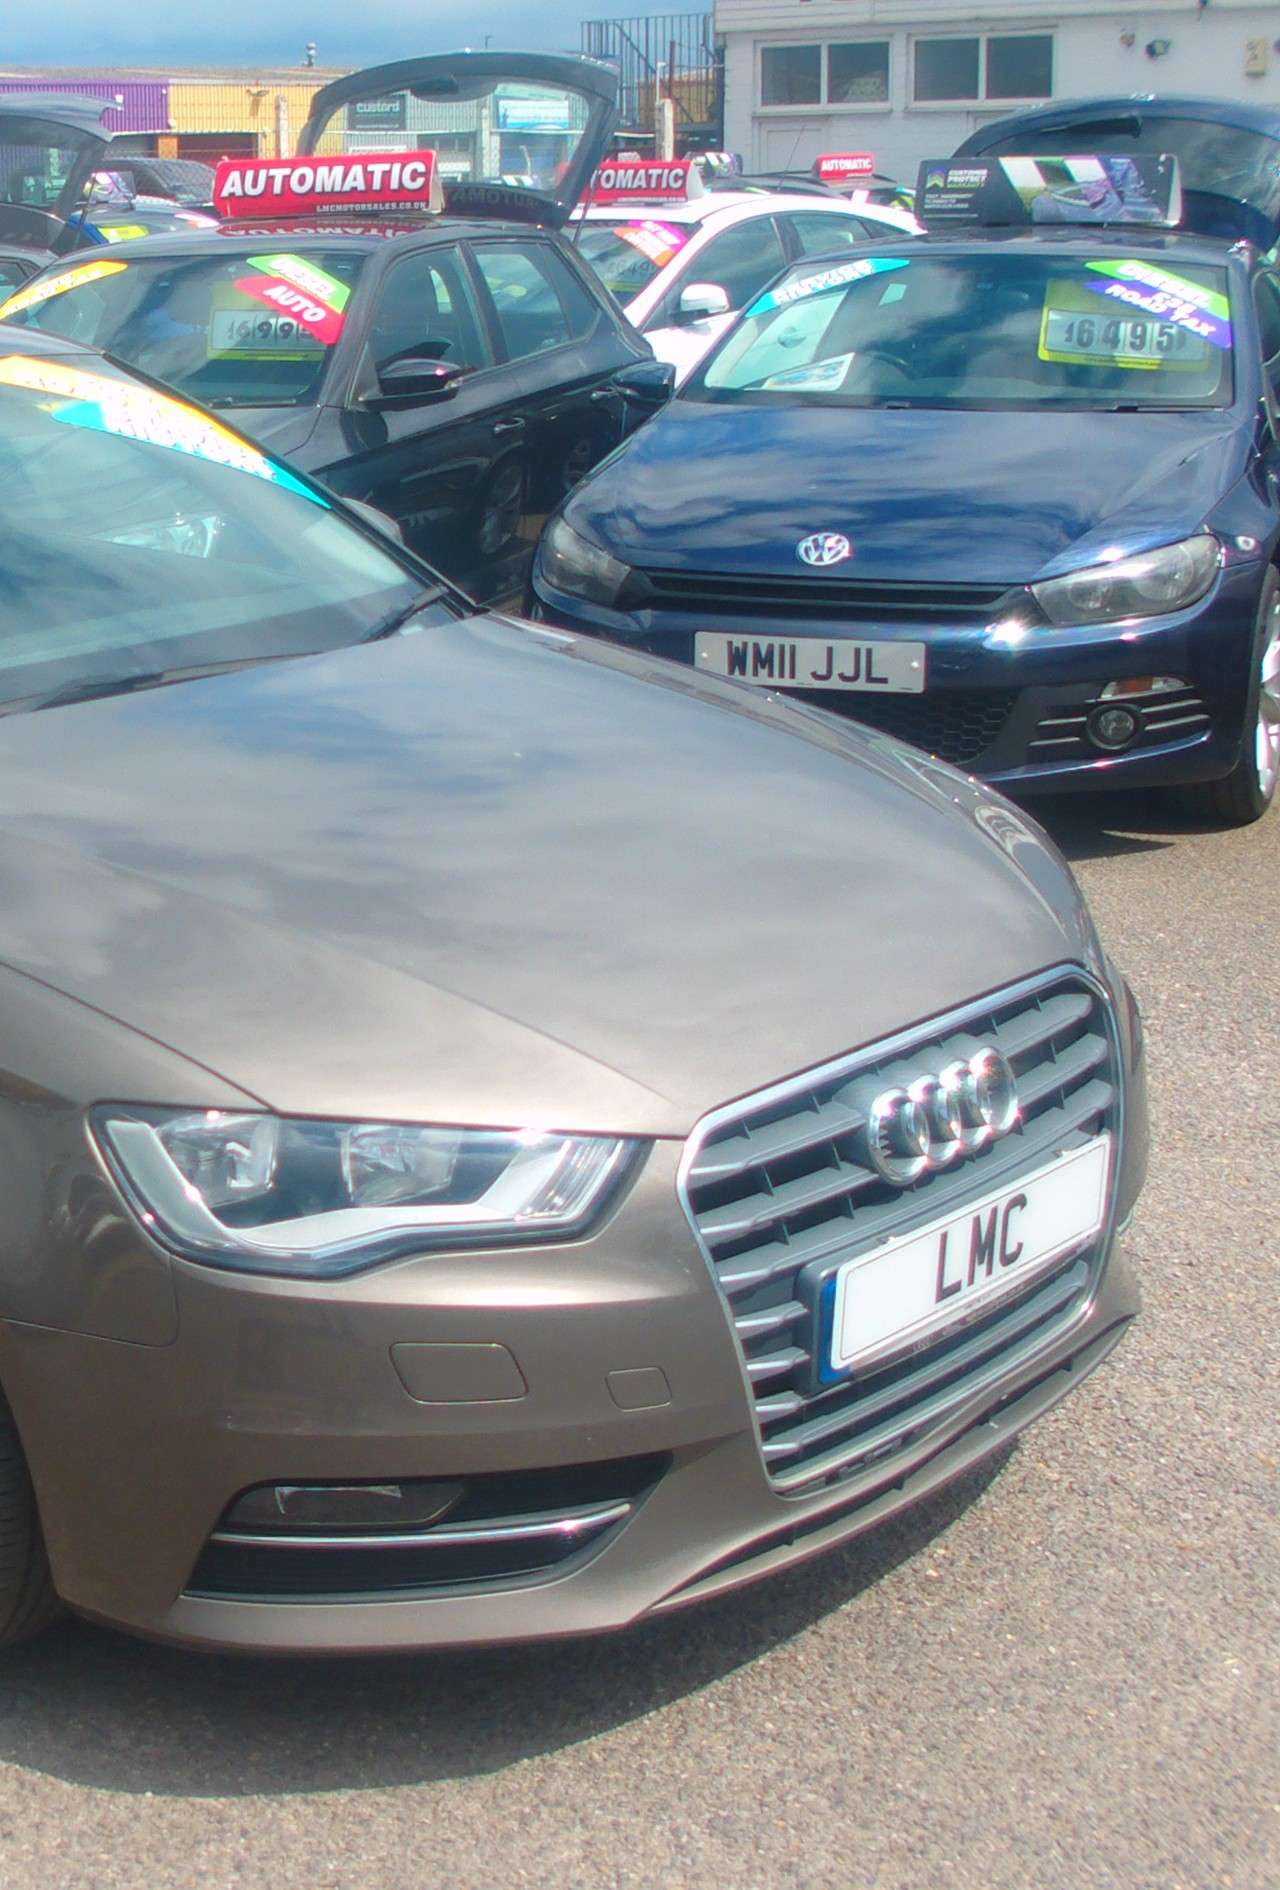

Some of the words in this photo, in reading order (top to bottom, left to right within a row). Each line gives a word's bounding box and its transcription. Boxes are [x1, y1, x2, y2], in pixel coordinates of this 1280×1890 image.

[220, 161, 427, 198] AUTOMATIC
[821, 157, 873, 172] AUTOMATIC
[315, 201, 427, 213] LMCMOTORSALES.CO.UK
[263, 285, 327, 322] AUTO
[809, 646, 889, 684] JJL
[933, 1193, 1028, 1304] LMC
